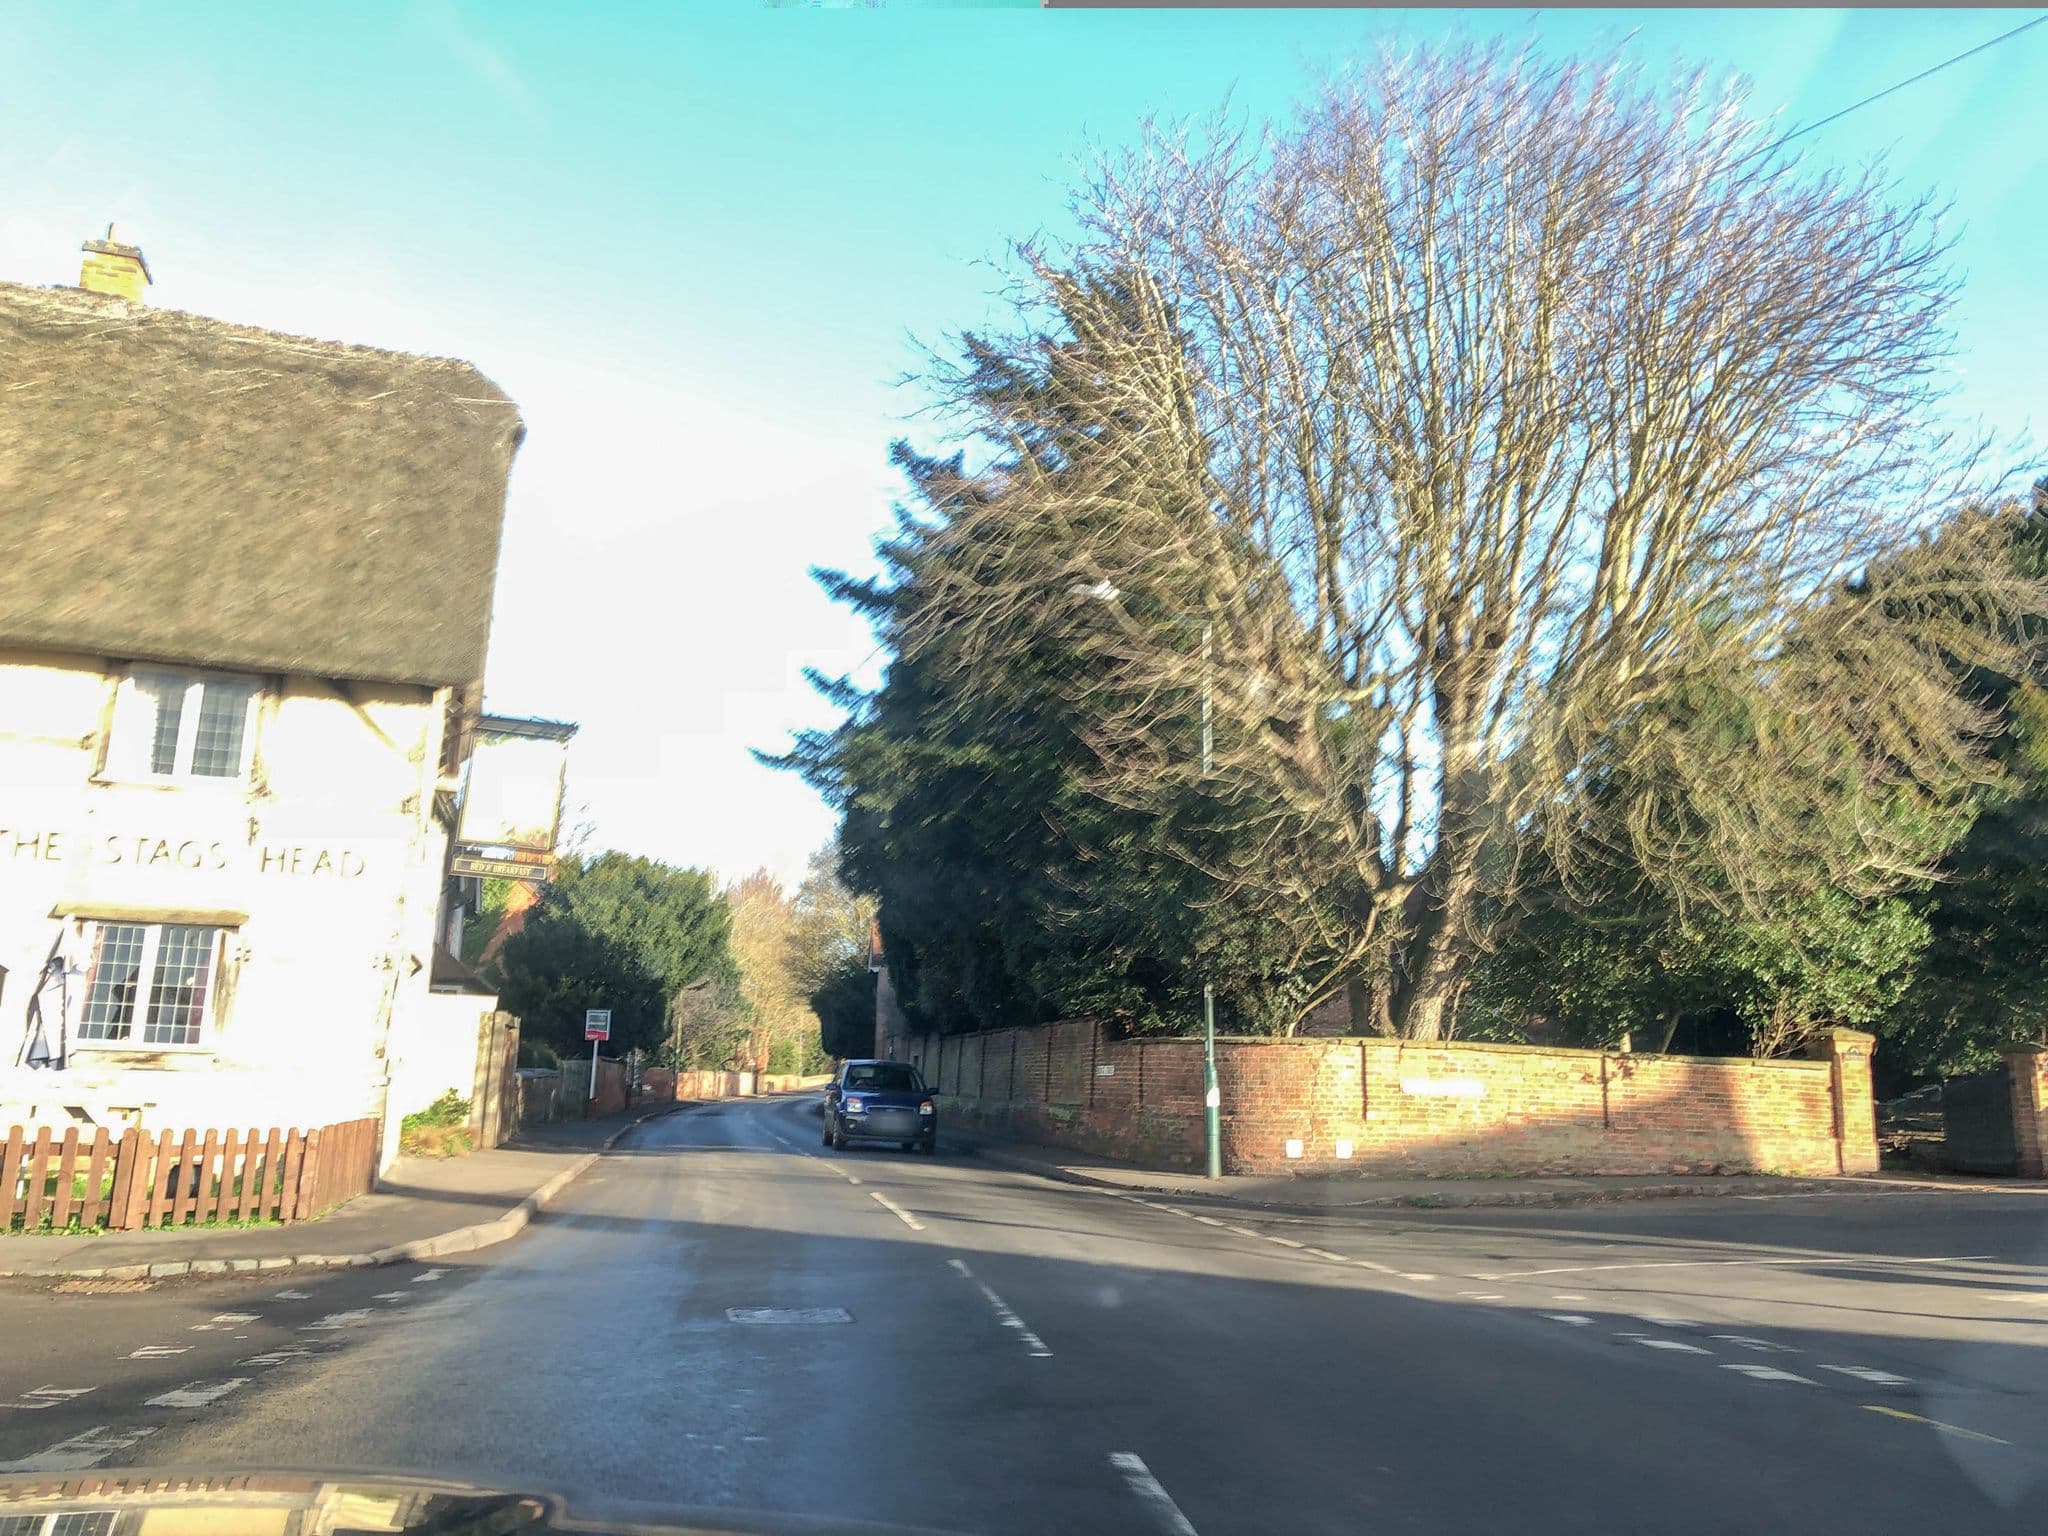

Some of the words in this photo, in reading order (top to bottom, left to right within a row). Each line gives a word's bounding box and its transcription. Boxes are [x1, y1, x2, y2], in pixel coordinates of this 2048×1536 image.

[105, 836, 227, 869] STAGS
[260, 846, 366, 877] HEAD
[493, 865, 531, 876] BREAKFAST
